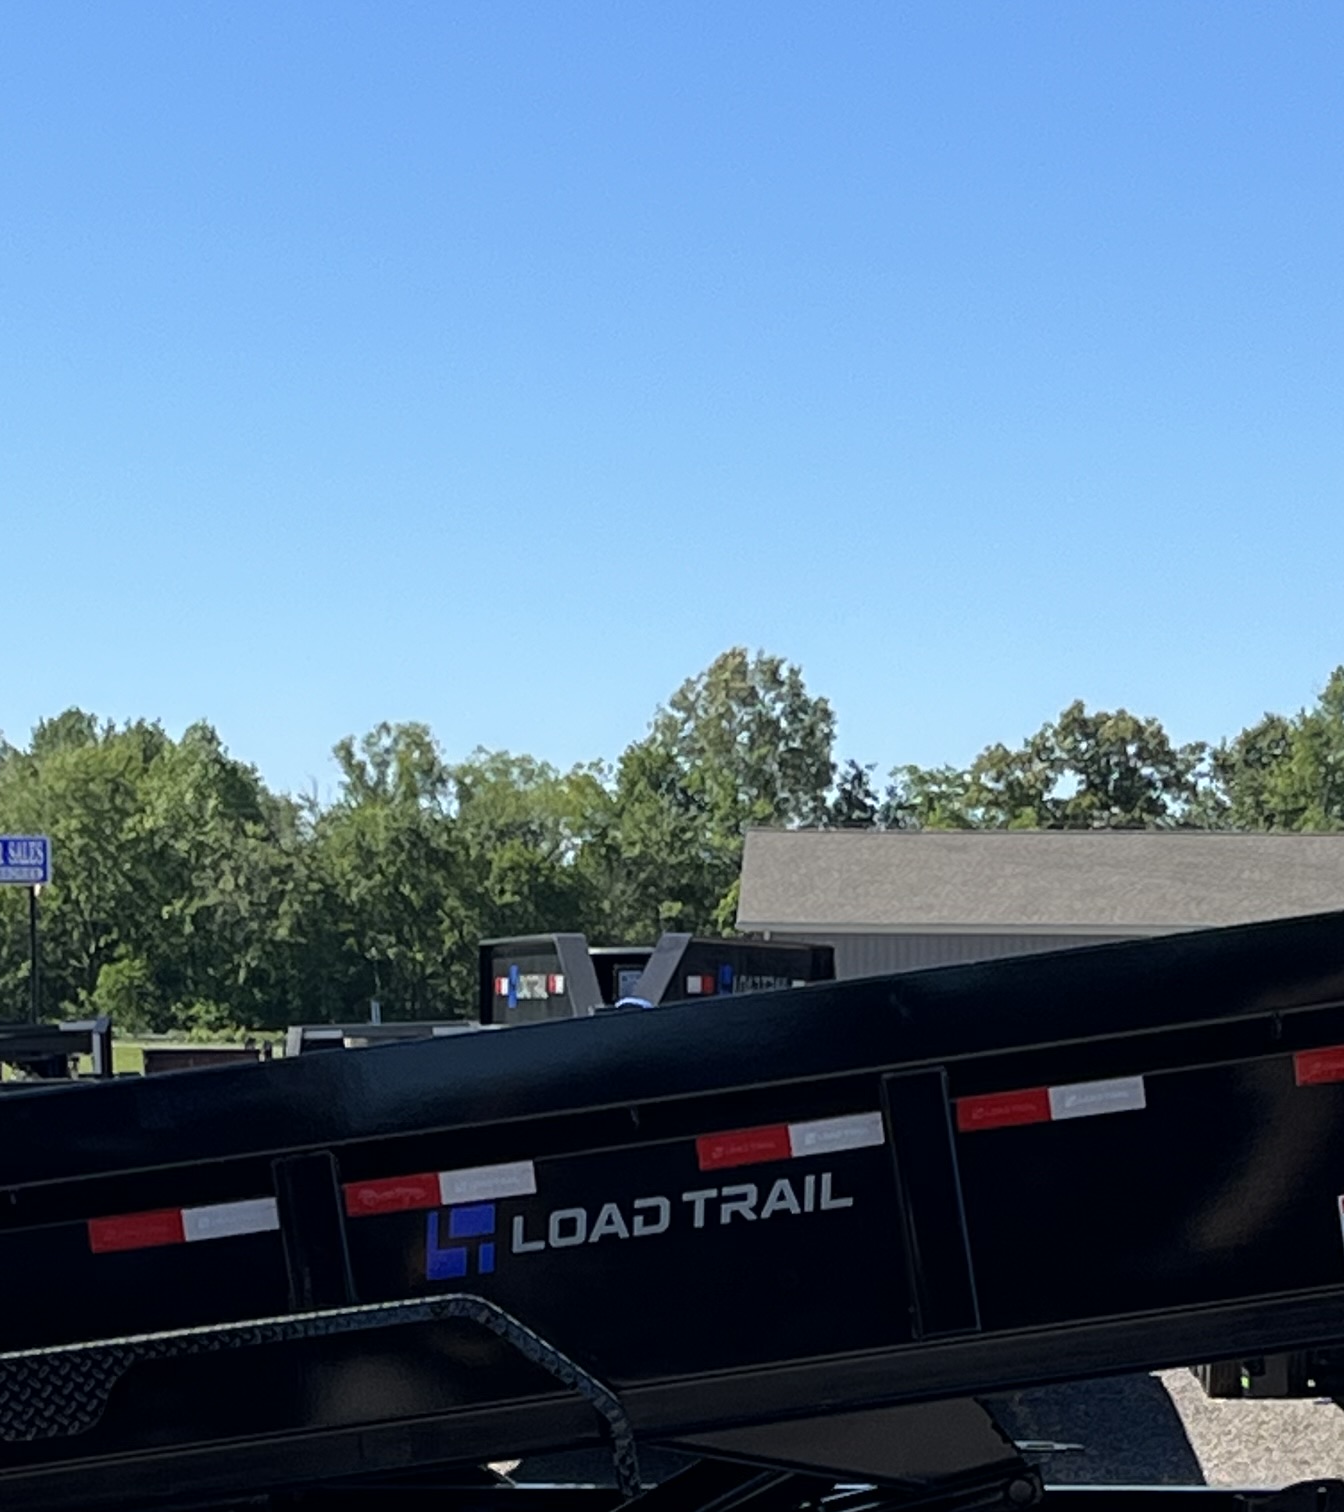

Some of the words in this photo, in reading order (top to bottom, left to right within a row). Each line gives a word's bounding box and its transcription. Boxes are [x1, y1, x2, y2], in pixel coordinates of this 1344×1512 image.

[8, 840, 44, 865] SALES
[512, 1196, 671, 1253] LOAD
[682, 1172, 854, 1229] TRAIL
